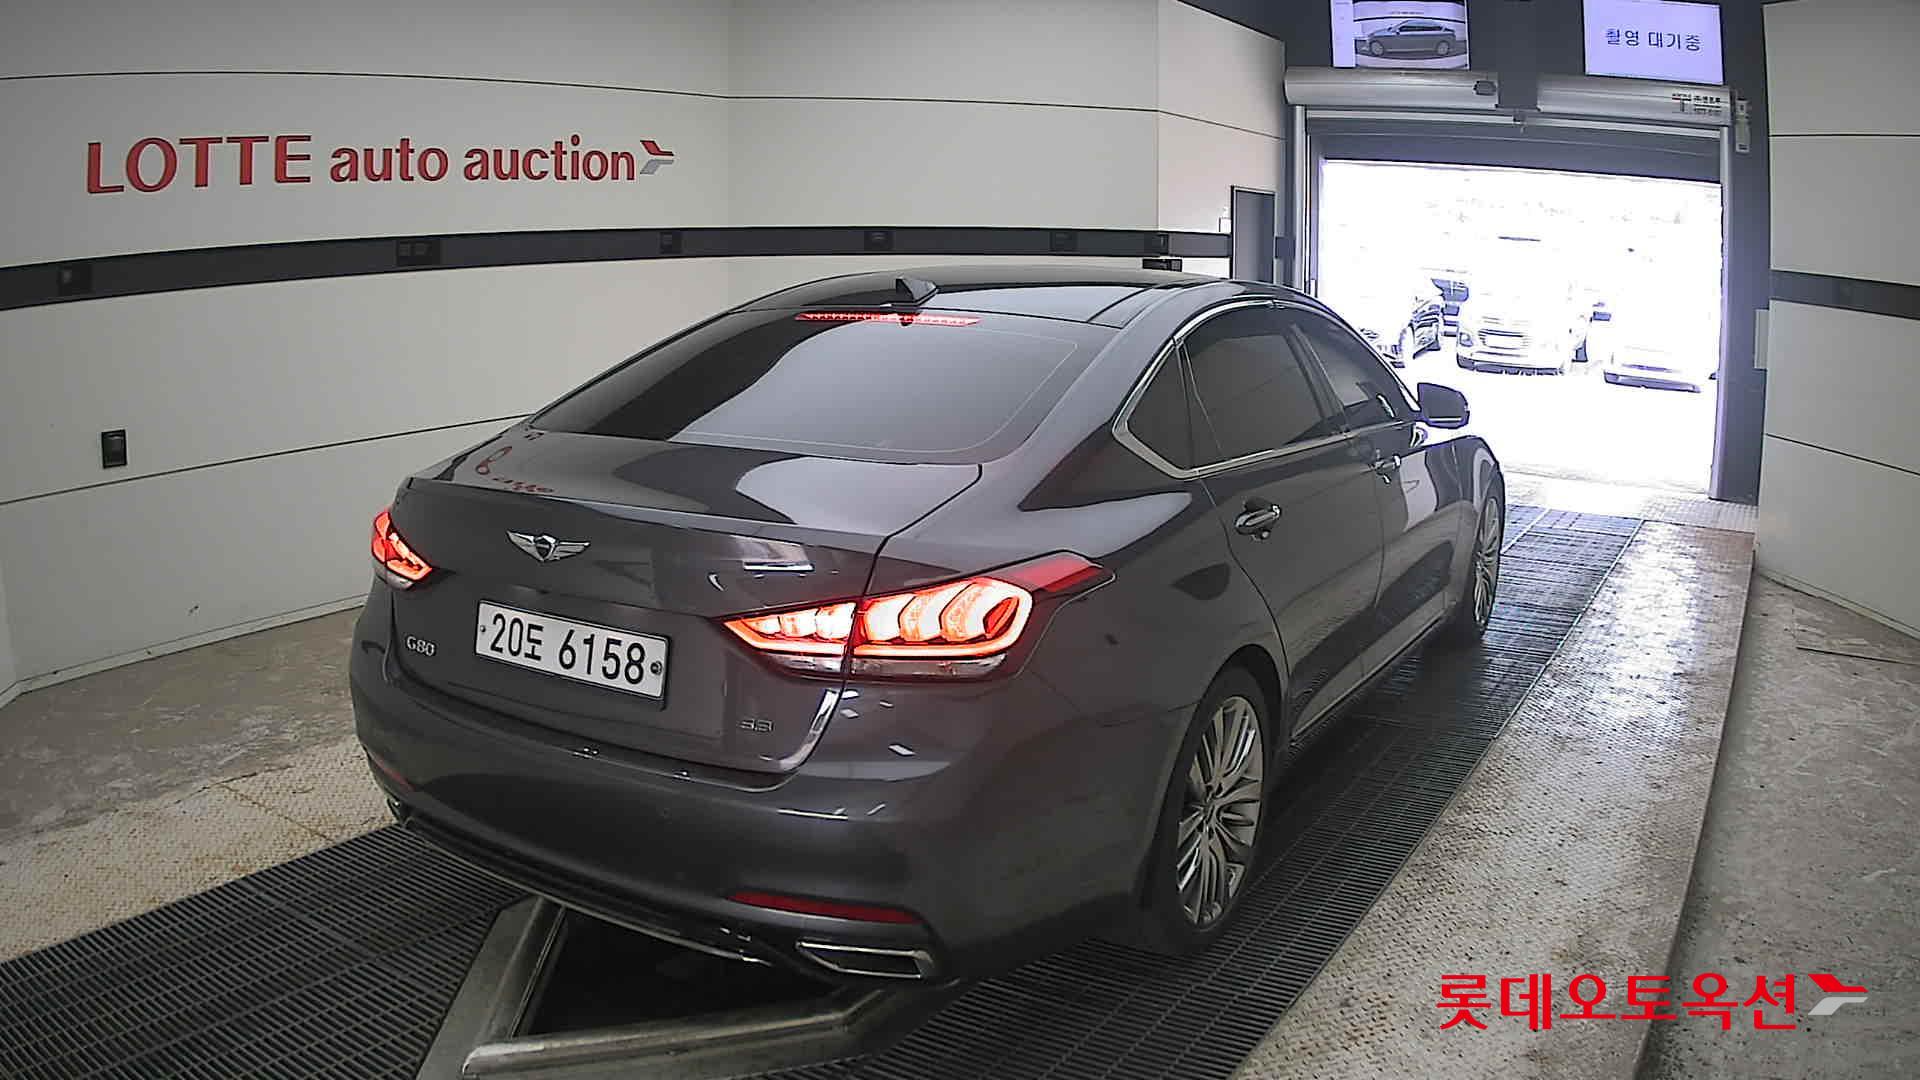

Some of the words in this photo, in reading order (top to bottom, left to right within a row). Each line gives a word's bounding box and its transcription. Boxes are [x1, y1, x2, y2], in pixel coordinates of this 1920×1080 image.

[86, 134, 312, 195] LOTTE
[329, 137, 449, 182] auto
[463, 134, 636, 182] auction
[406, 635, 435, 657] G80
[490, 613, 544, 661] 20도
[558, 629, 646, 685] 6158
